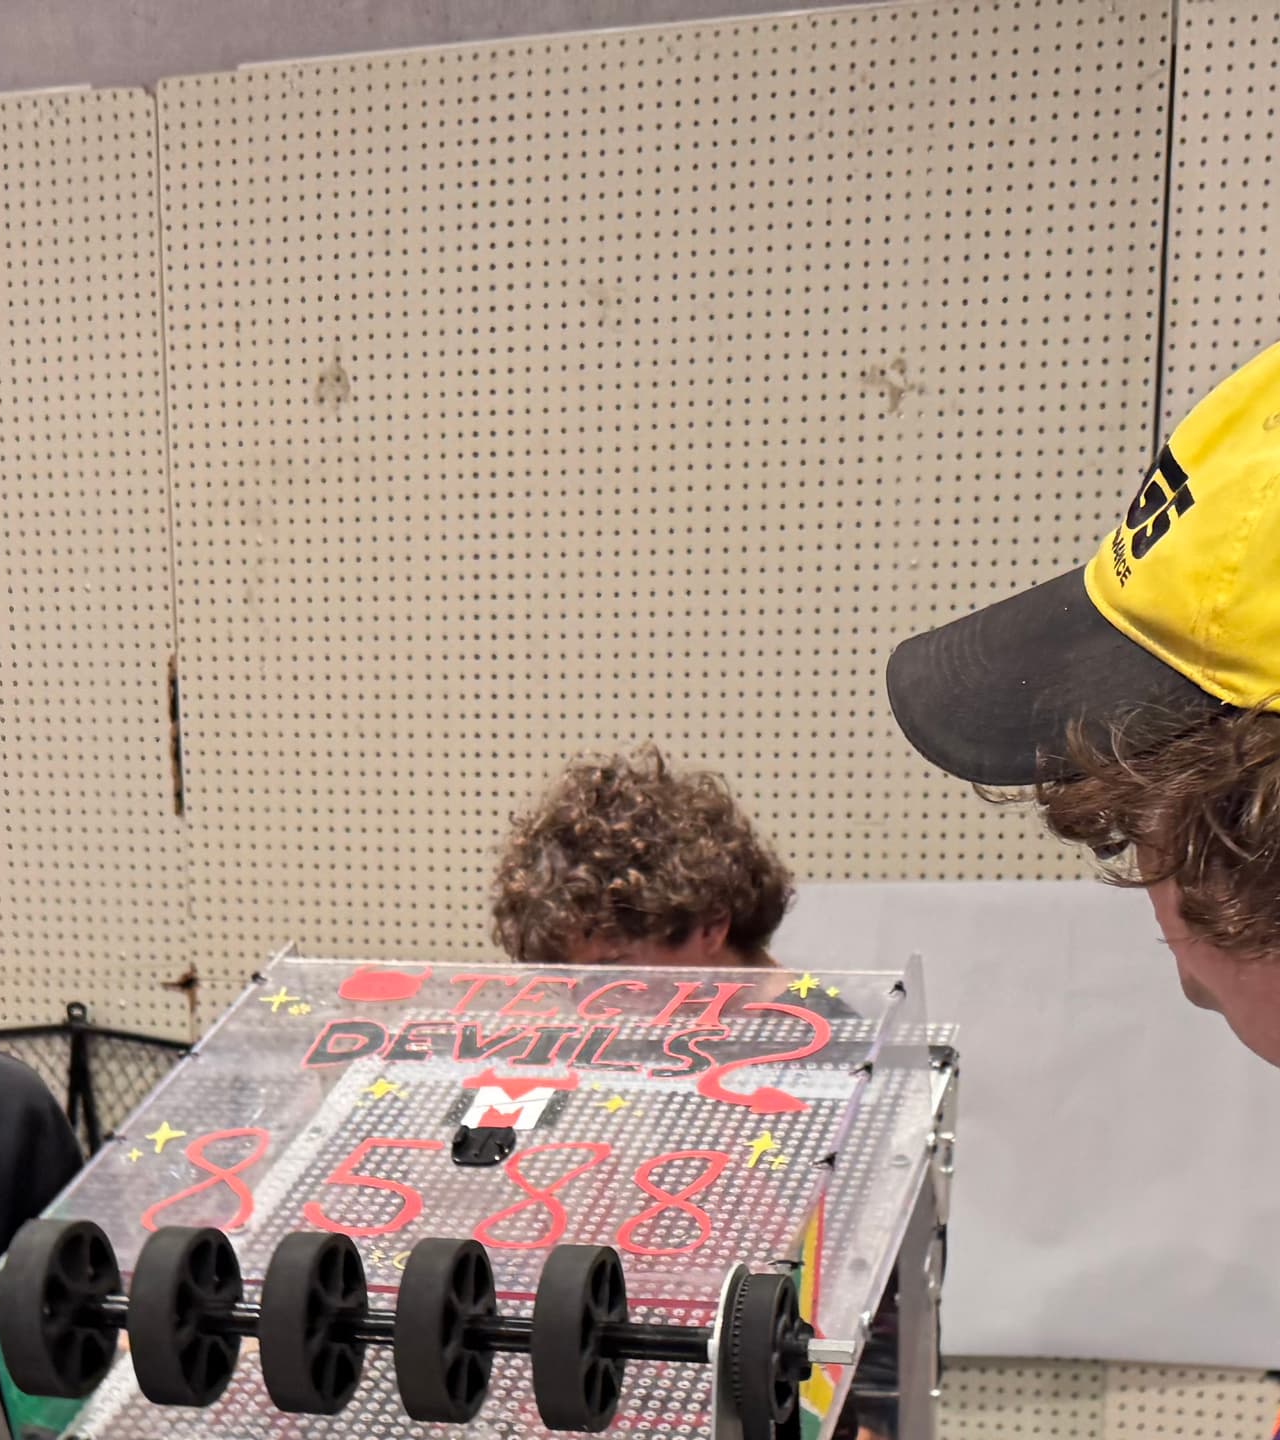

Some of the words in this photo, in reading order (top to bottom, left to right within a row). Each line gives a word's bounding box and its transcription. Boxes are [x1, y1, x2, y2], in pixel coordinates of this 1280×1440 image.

[450, 973, 757, 1026] TECH
[301, 1019, 730, 1079] DEVILS
[141, 1128, 730, 1256] 8588
